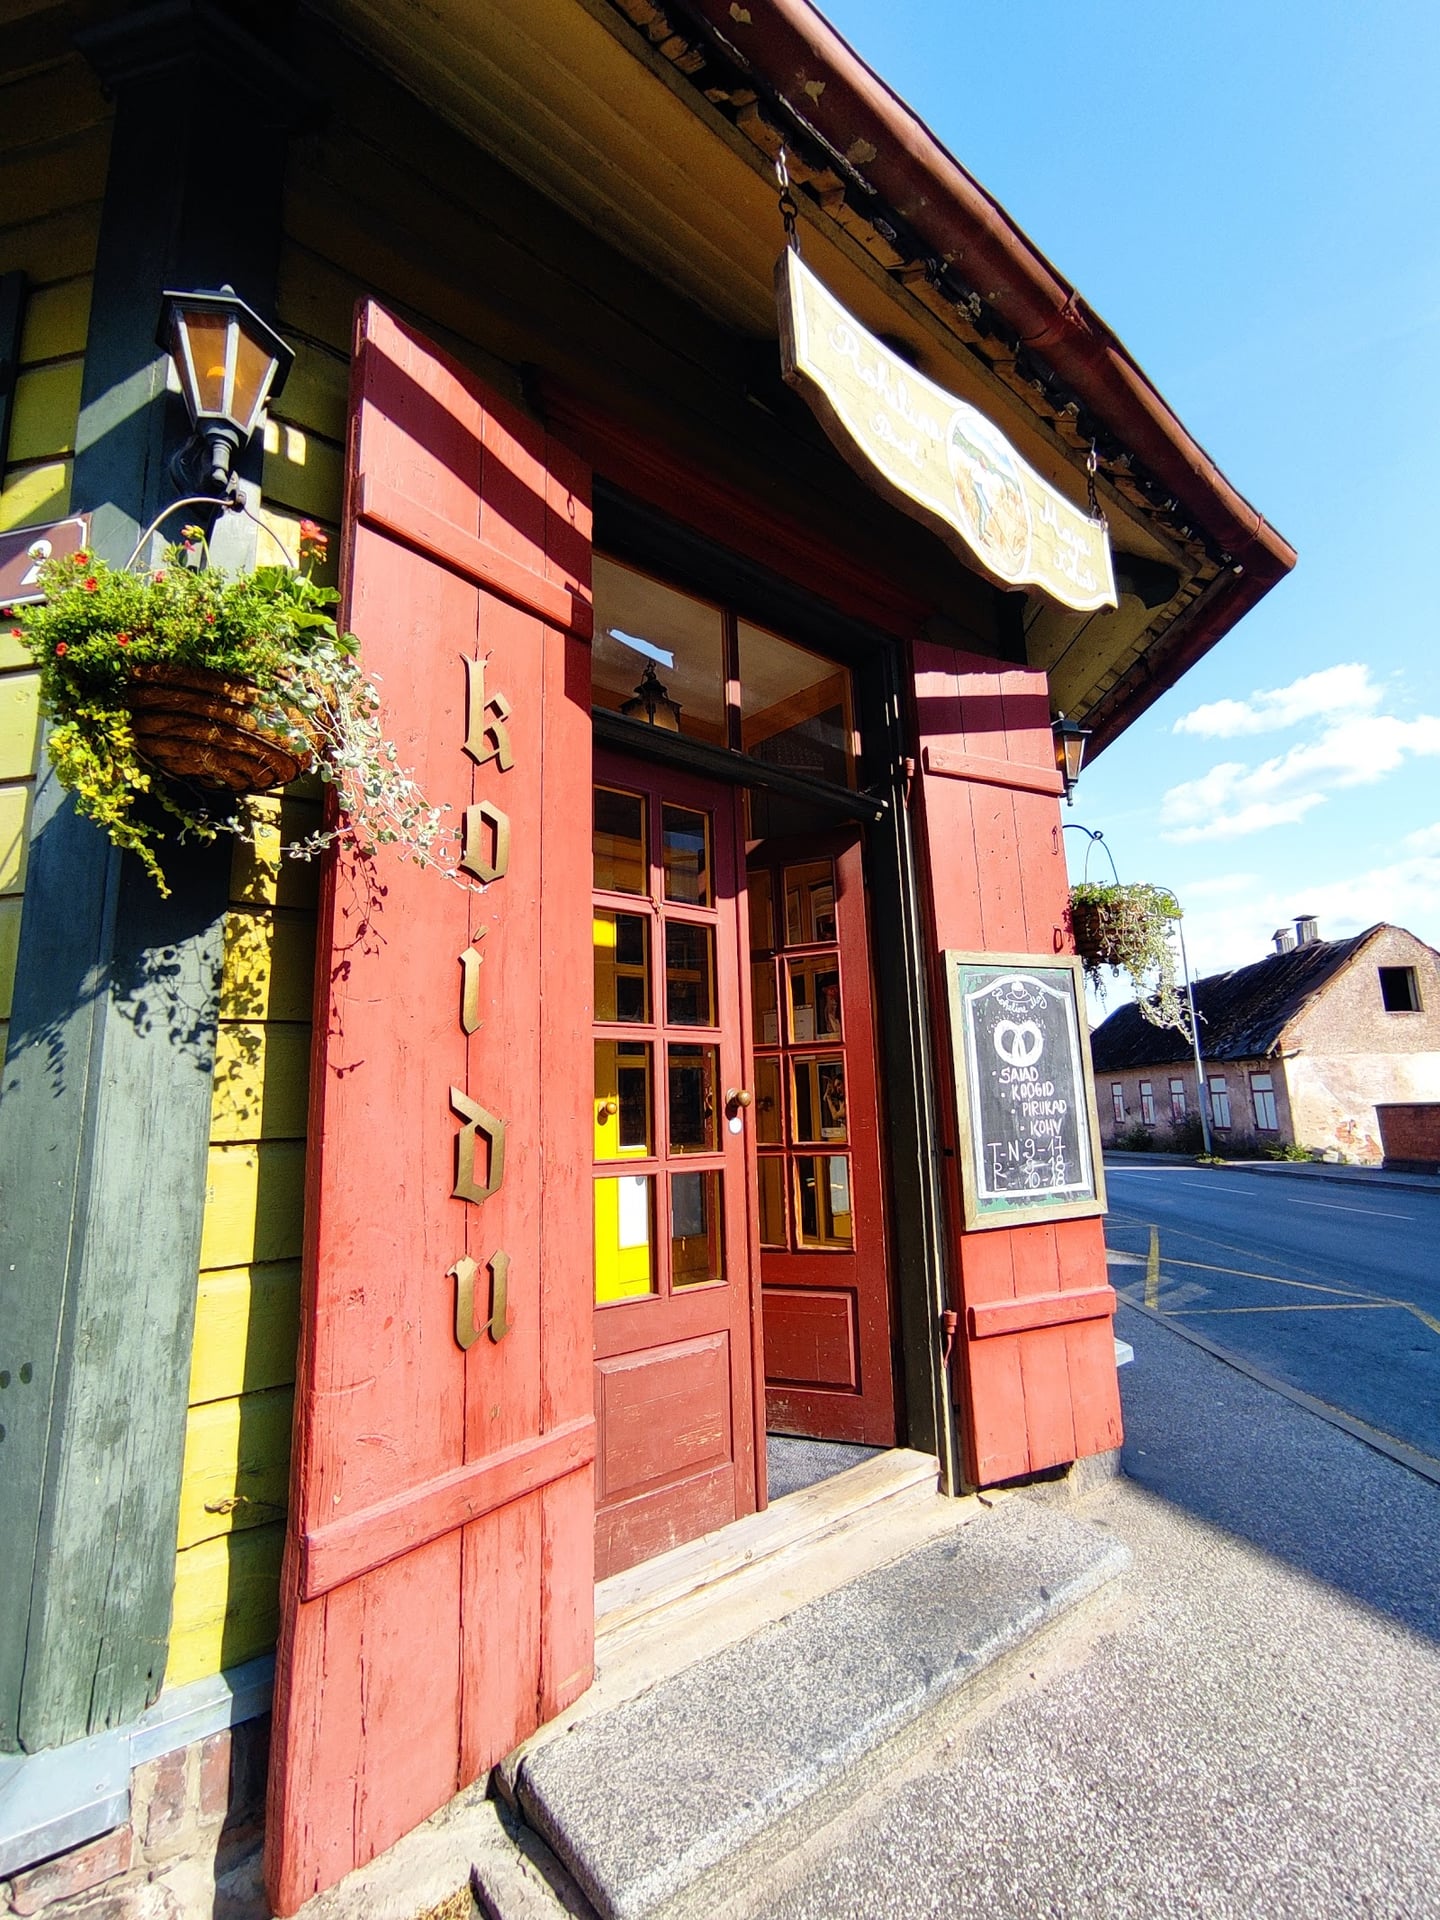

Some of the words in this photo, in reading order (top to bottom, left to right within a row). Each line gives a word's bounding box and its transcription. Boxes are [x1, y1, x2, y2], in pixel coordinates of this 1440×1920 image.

[999, 1067, 1039, 1083] SAIAD
[1022, 1099, 1067, 1116] PIRUKAD
[1030, 1119, 1062, 1137] KOHV
